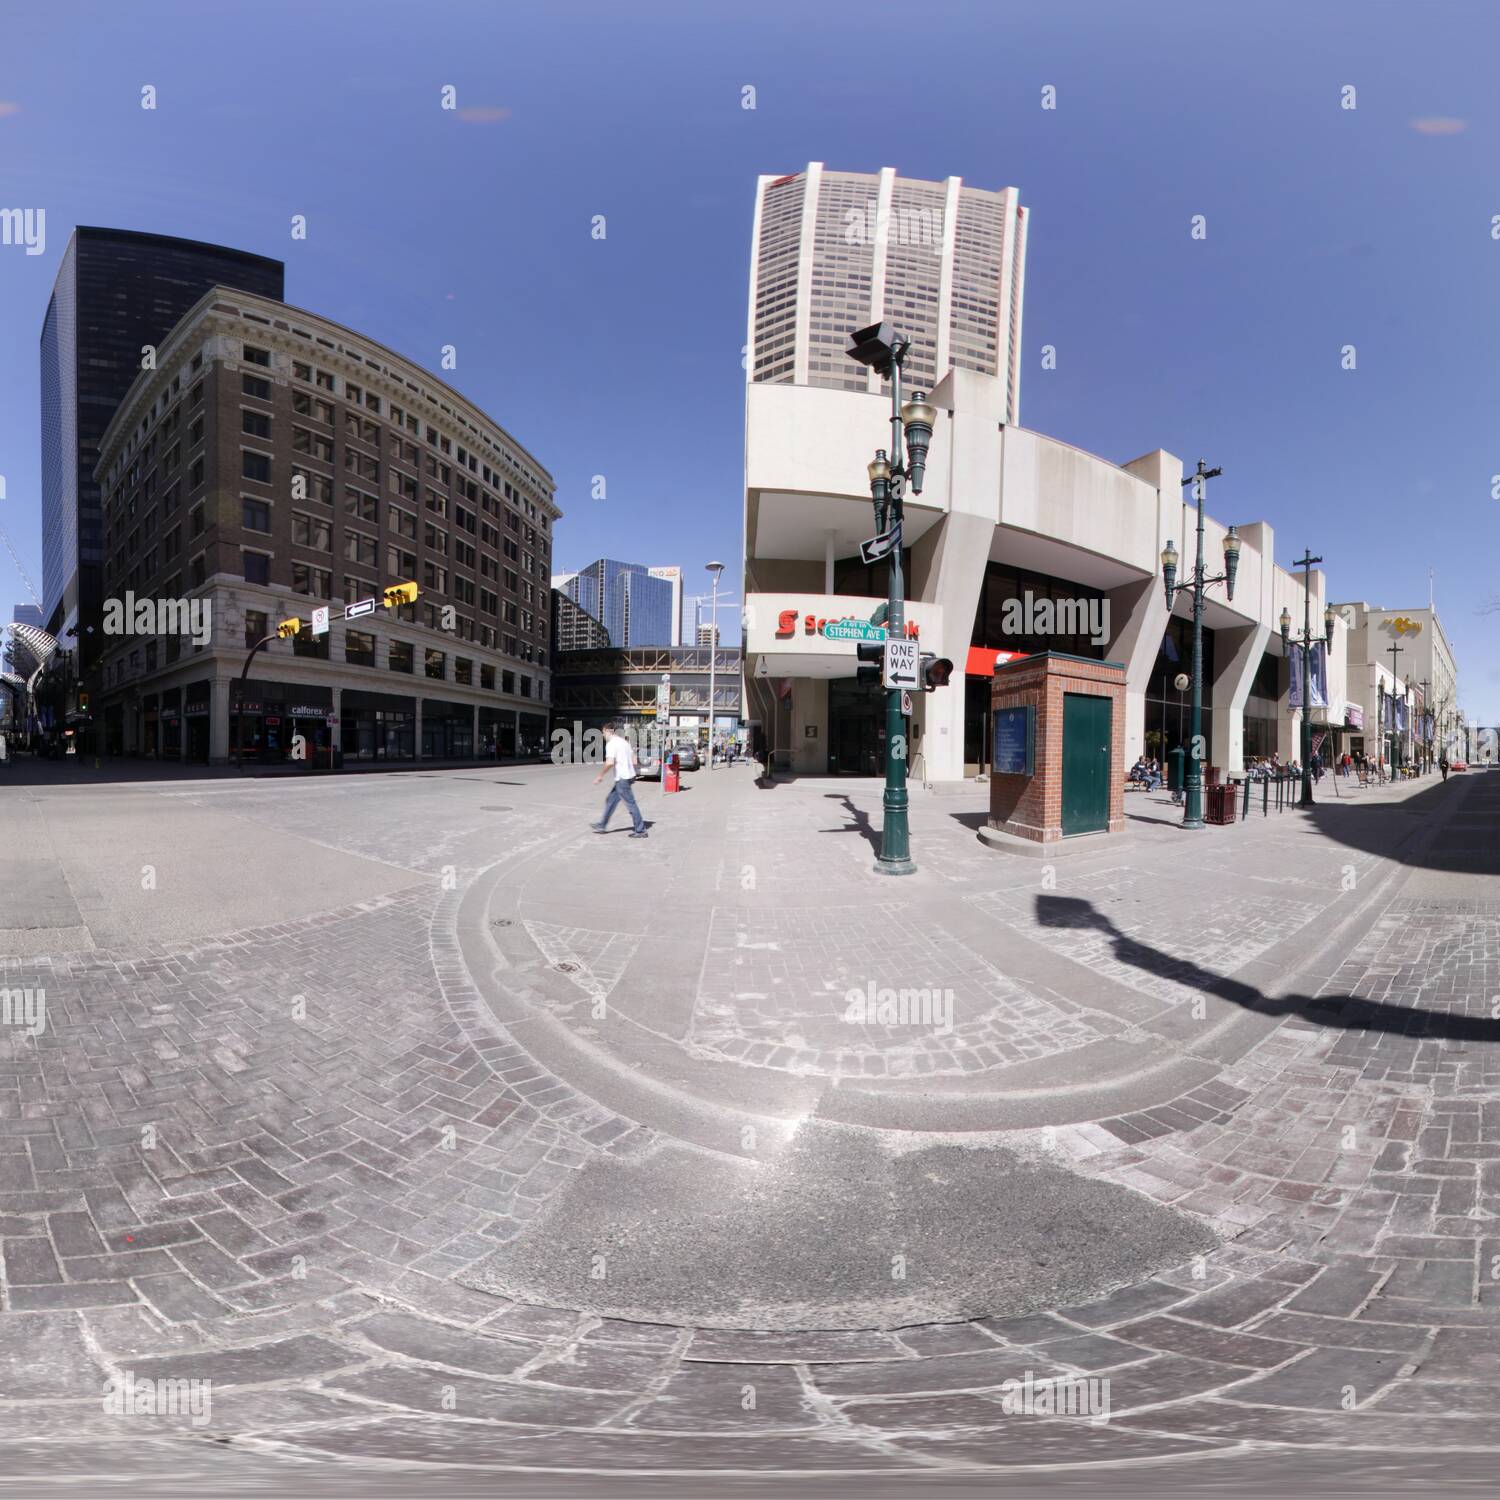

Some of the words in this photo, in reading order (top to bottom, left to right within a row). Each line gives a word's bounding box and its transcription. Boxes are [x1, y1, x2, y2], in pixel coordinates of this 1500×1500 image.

[829, 627, 864, 638] STEPHEN
[866, 629, 881, 639] AVE
[890, 644, 914, 658] ONE
[890, 657, 915, 670] WAY
[292, 705, 323, 715] calforex
